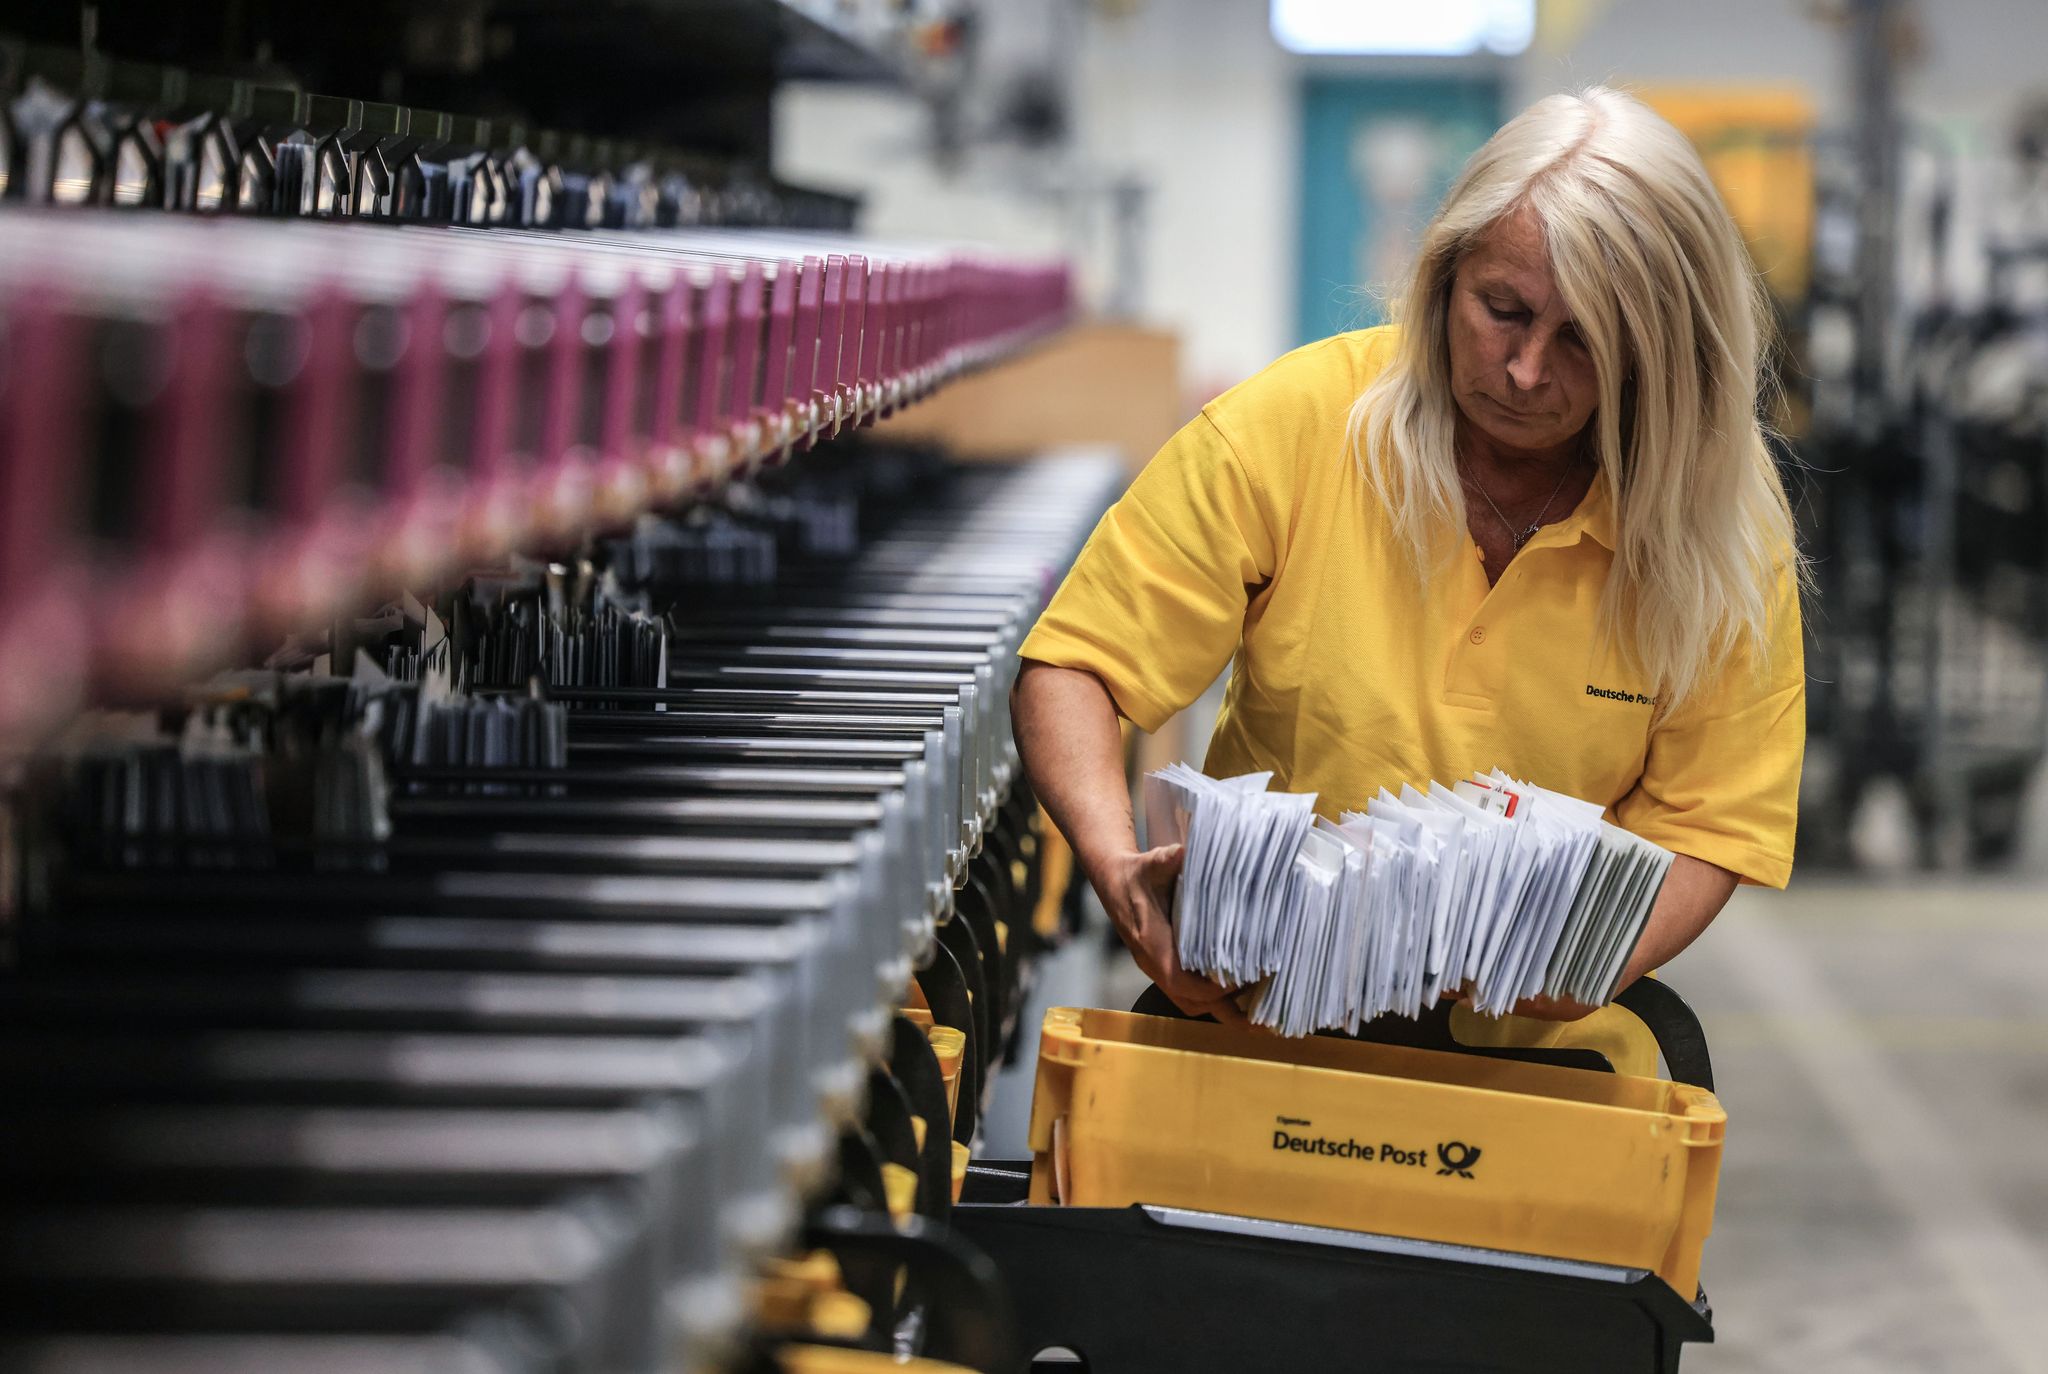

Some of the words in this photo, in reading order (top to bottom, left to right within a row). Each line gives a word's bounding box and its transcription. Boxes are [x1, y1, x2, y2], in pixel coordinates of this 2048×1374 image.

[1586, 685, 1634, 703] Deutsche
[1273, 1131, 1375, 1160] Deutsche
[1379, 1143, 1428, 1167] Post
